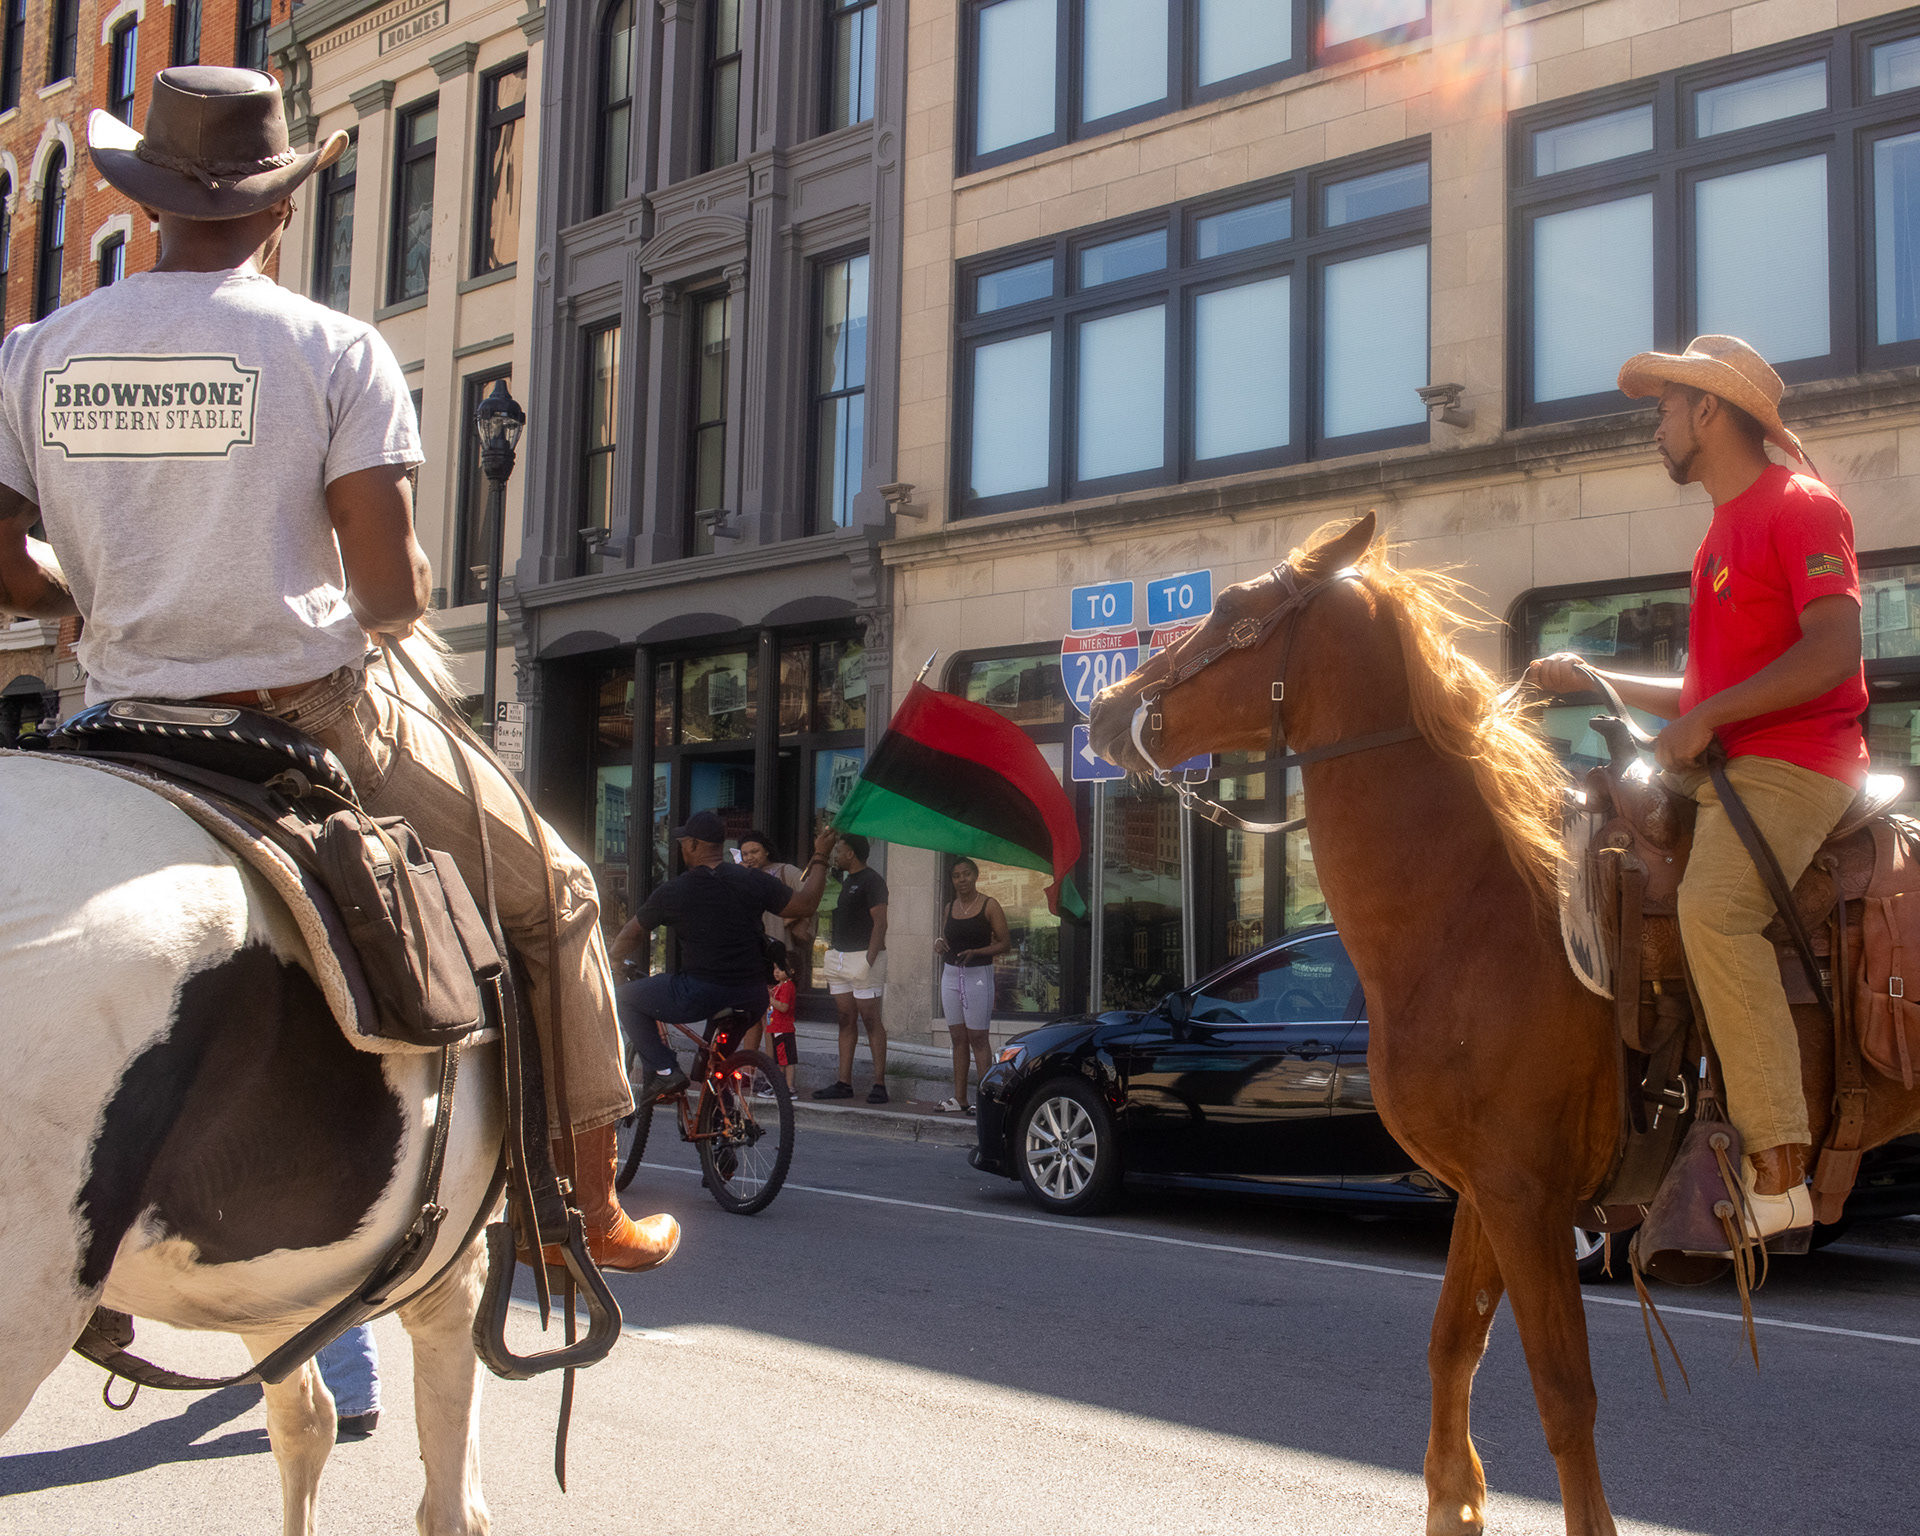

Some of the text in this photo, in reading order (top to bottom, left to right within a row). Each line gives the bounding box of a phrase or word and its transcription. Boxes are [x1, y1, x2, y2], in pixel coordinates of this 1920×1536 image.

[388, 10, 439, 48] HOLMES
[54, 382, 244, 408] BROWNSTONE
[51, 410, 243, 431] WESTERN STABLE
[1087, 593, 1116, 620] TO
[1163, 584, 1194, 613] TO
[1079, 635, 1122, 650] INTERSTATE
[1075, 652, 1127, 703] 280
[498, 704, 507, 718] 2
